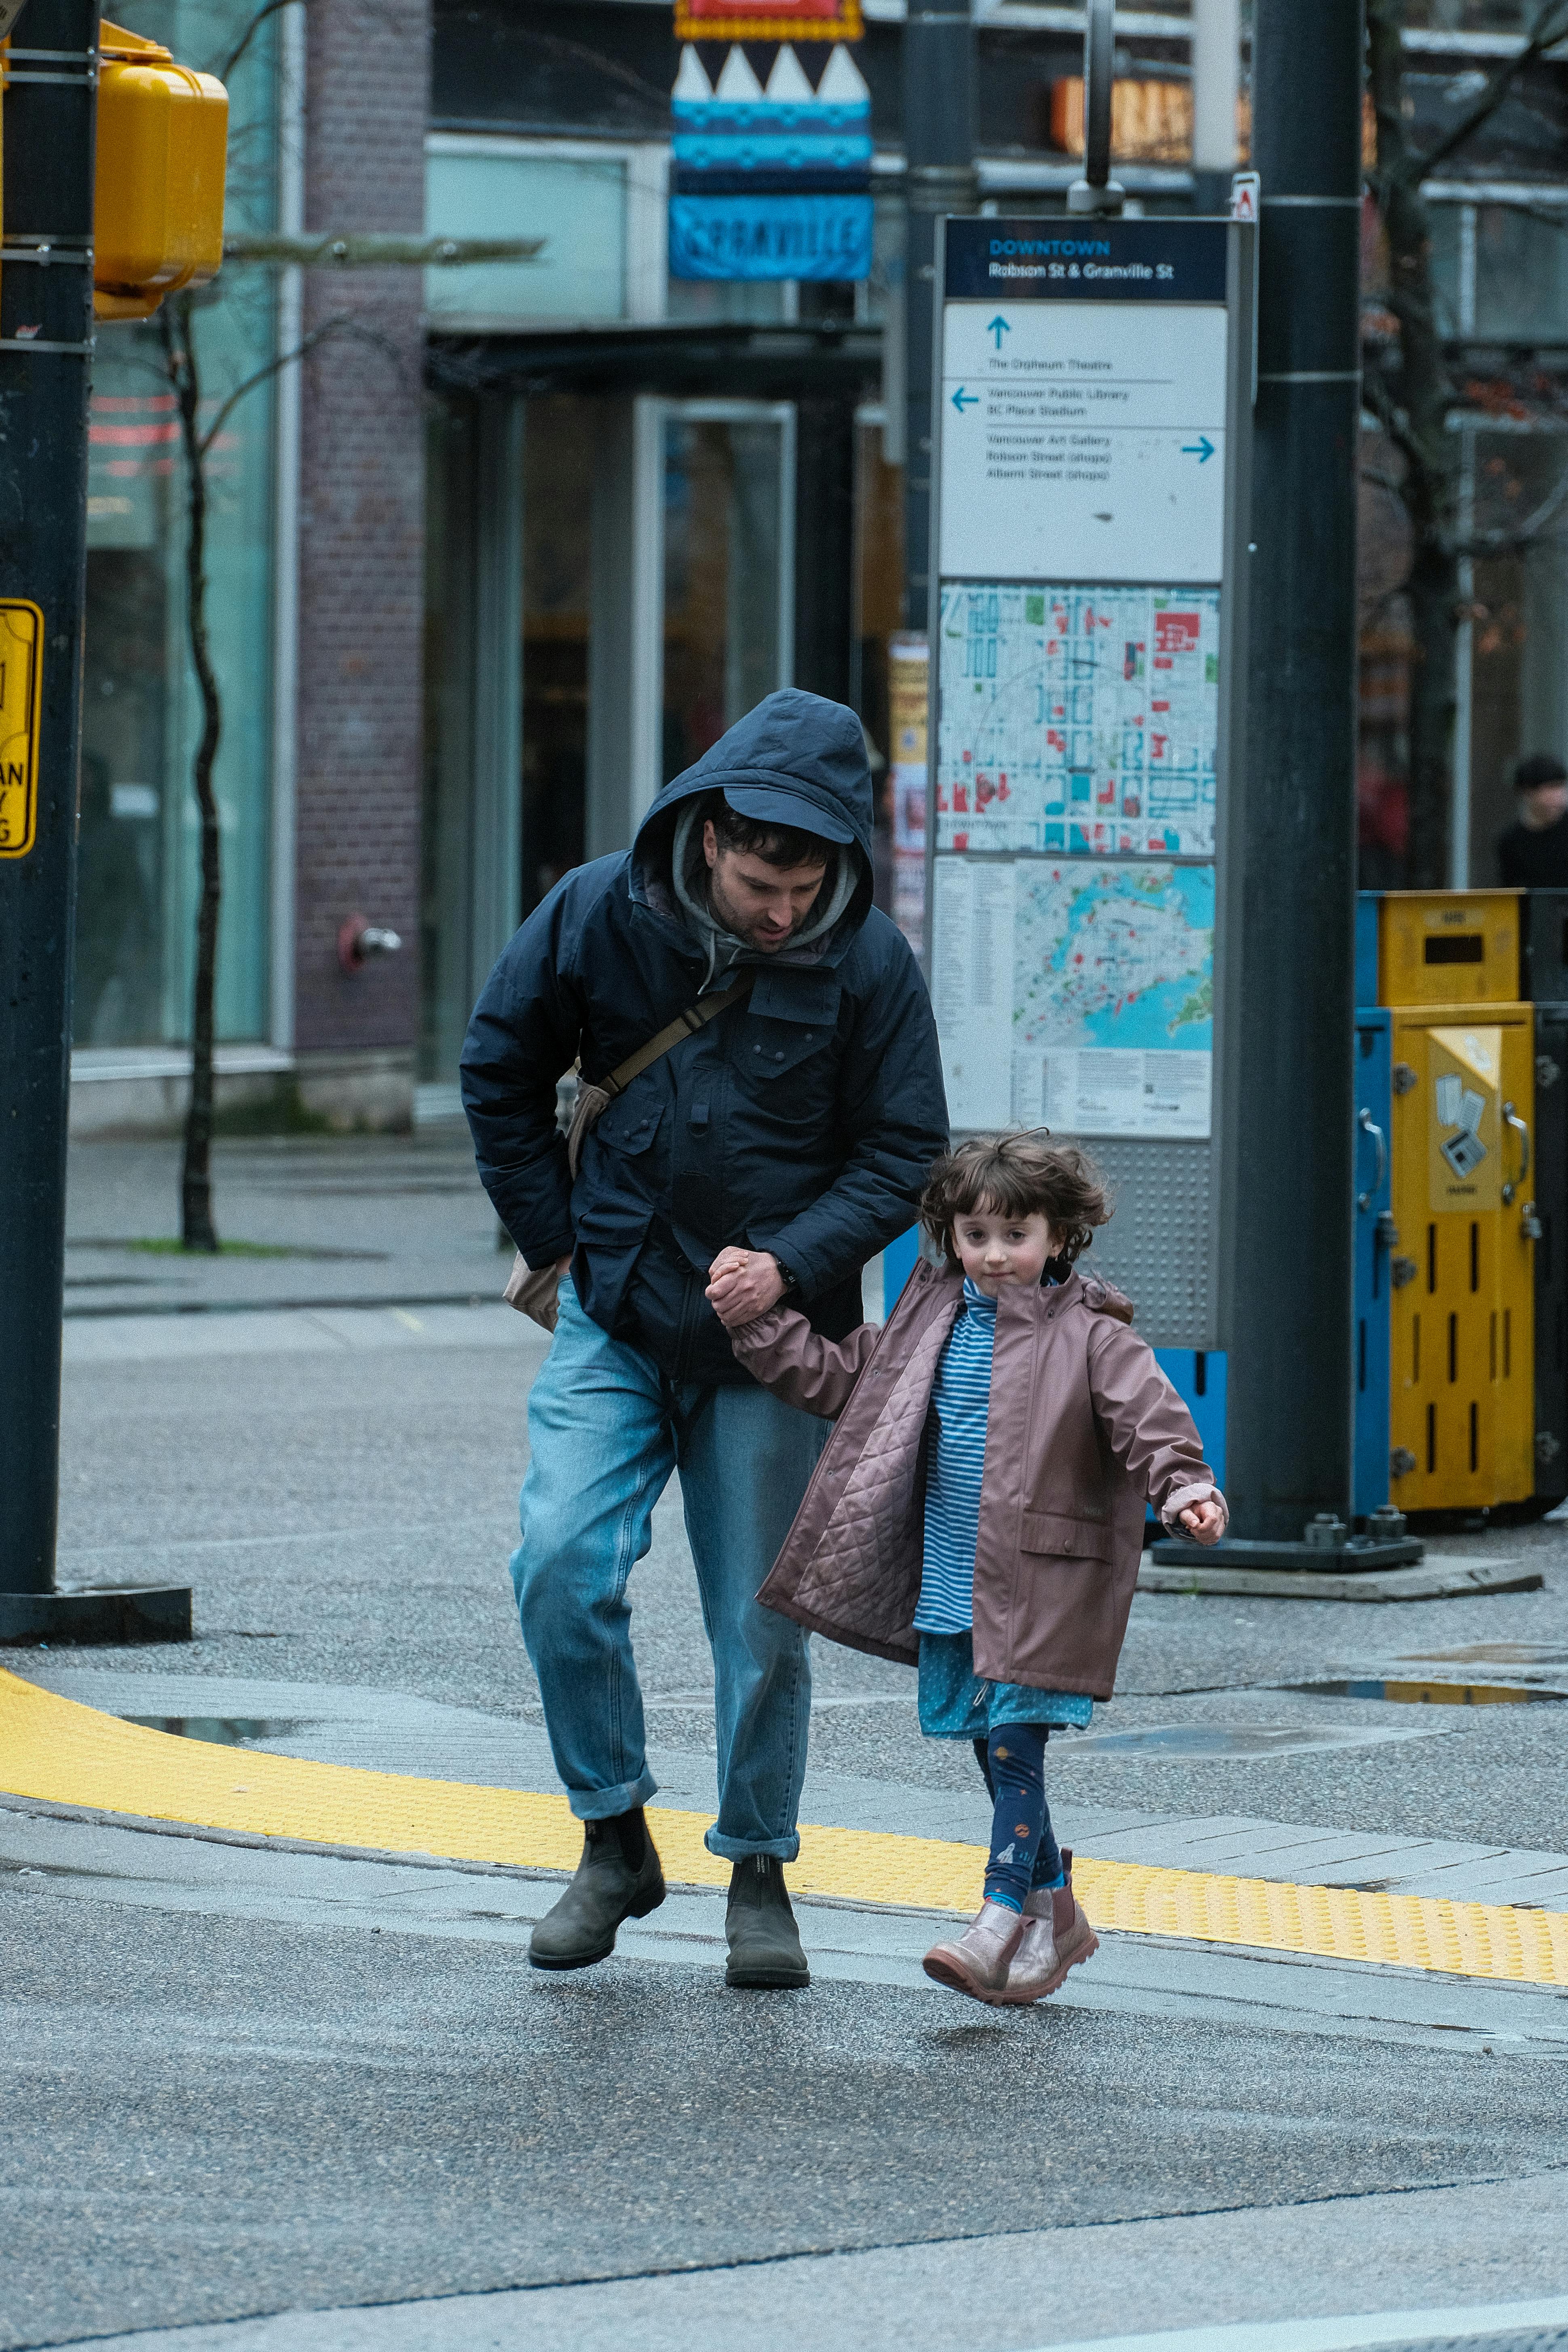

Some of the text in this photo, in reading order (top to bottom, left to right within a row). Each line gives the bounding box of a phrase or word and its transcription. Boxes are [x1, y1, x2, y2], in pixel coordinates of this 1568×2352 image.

[989, 239, 1111, 256] DOWNTOWN
[989, 262, 1175, 279] Robson St & Granville St
[989, 358, 1112, 371] The Orpheum Theatre
[987, 388, 1129, 404] Vancouver Public Library
[987, 406, 1086, 416] BC Place Stadium
[987, 434, 1110, 448] Vancouver Art Gallery
[987, 450, 1112, 465] Robson Street (shops)
[1029, 468, 1062, 479] Street
[1067, 469, 1109, 481] (shops)
